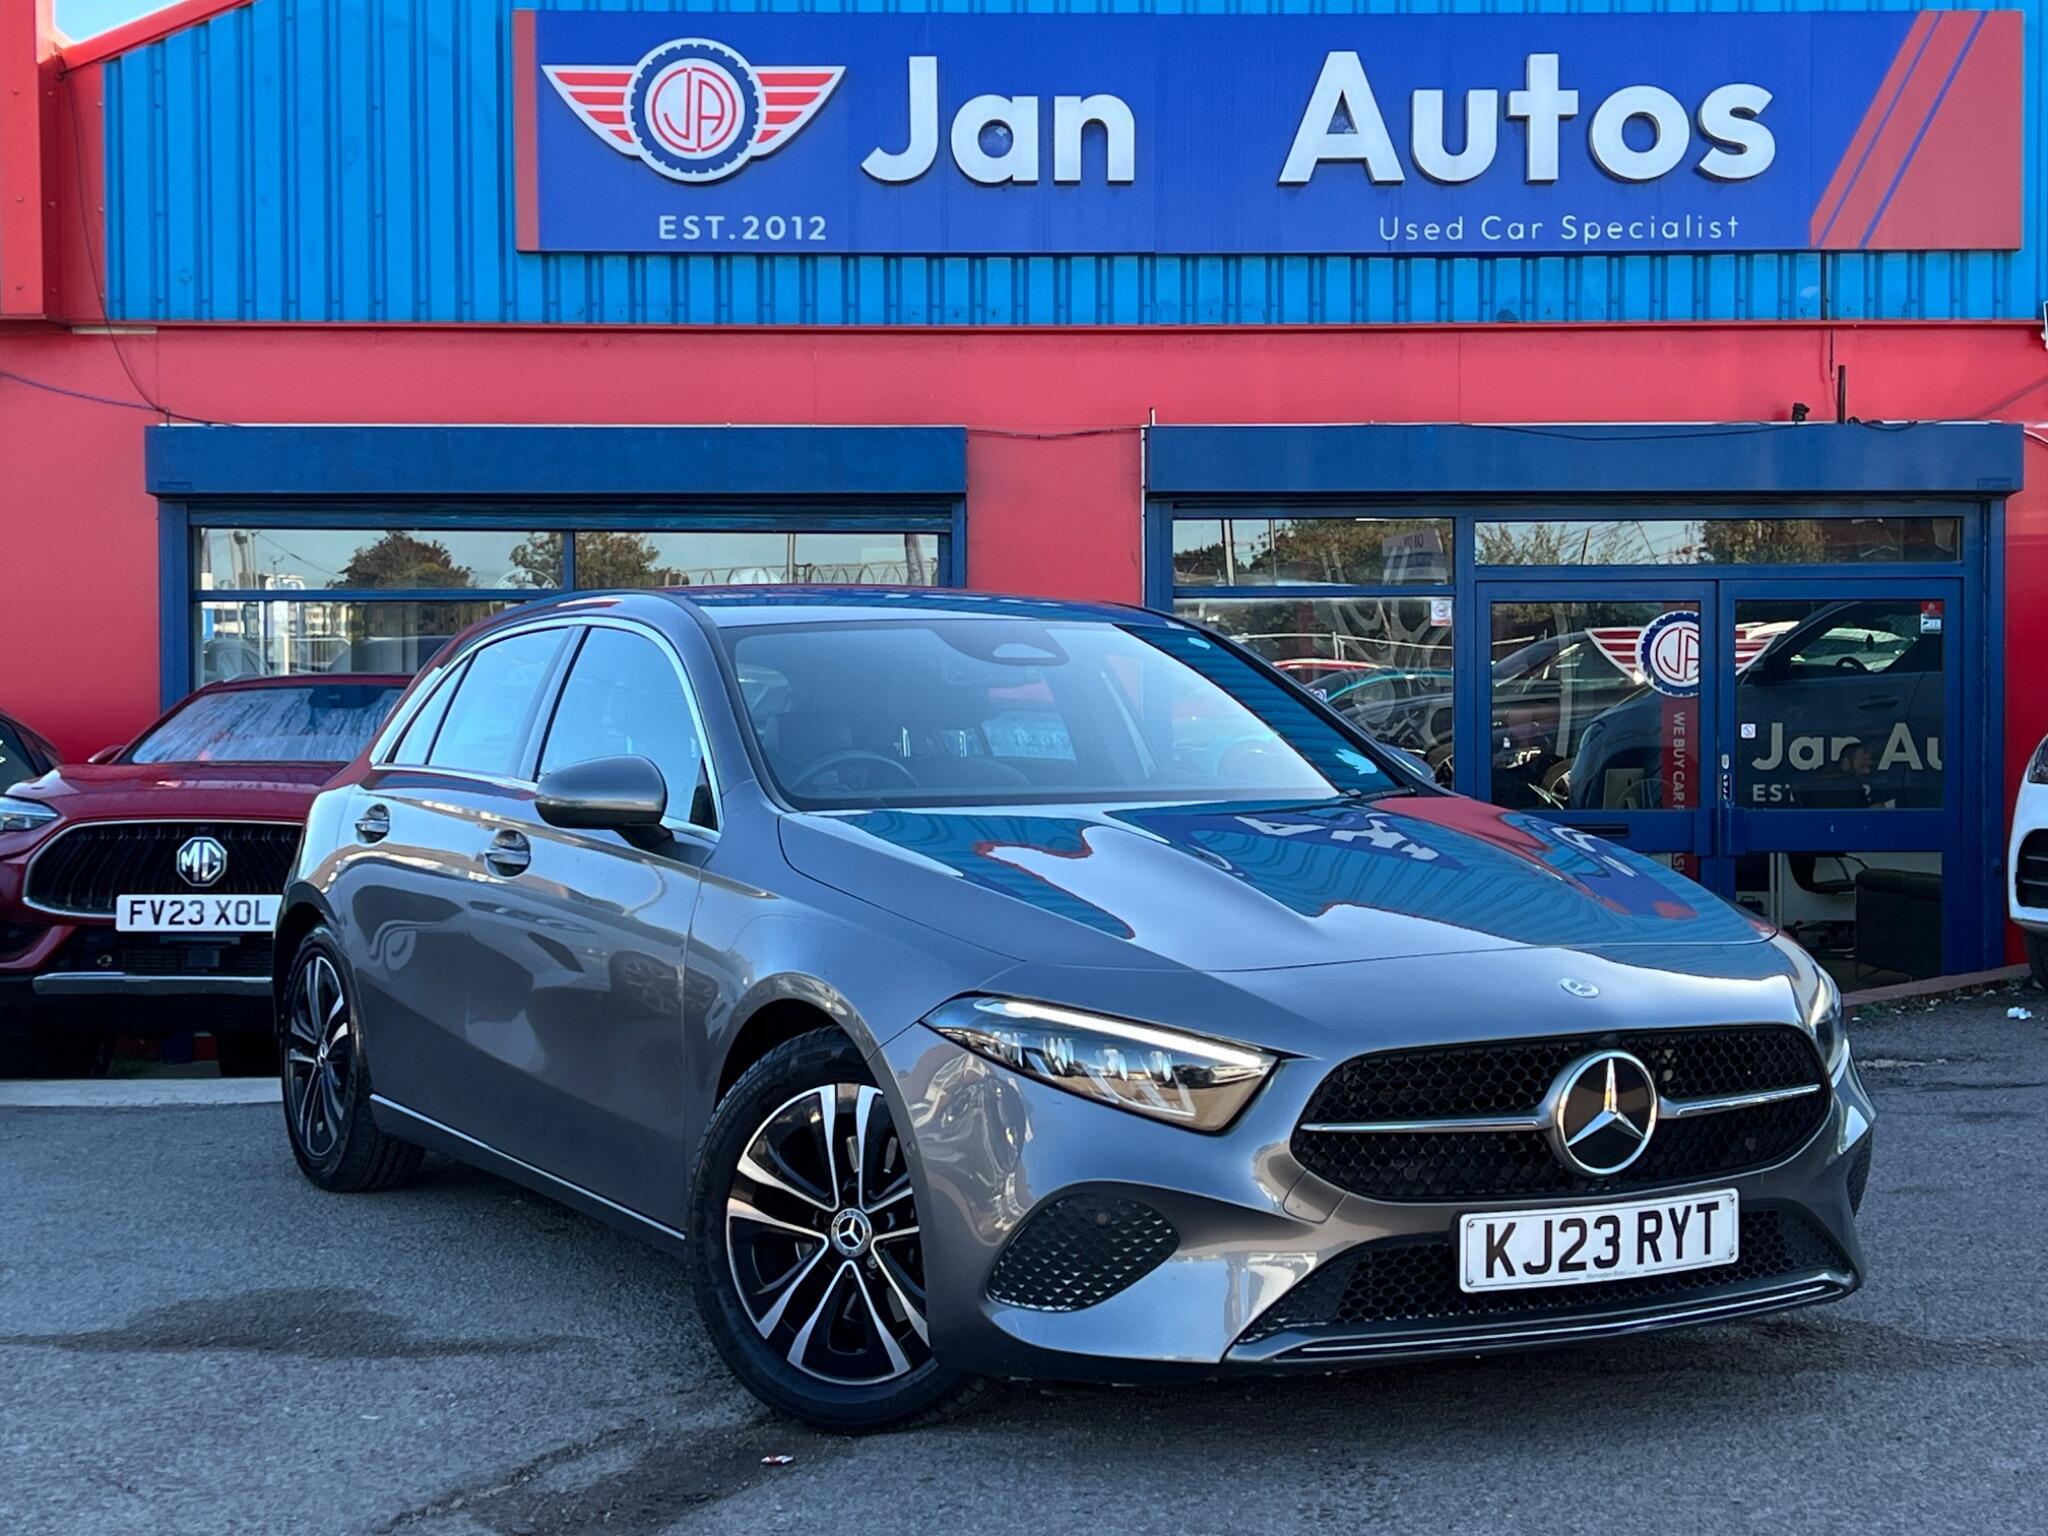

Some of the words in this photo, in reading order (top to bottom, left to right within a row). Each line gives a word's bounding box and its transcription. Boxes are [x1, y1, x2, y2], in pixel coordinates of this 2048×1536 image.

[861, 55, 1135, 184] Jan
[1278, 51, 1776, 183] Autos
[658, 215, 827, 241] EST.2012
[1379, 215, 1464, 241] Used
[1481, 214, 1543, 241] Car
[1560, 213, 1739, 246] Specialist
[1672, 711, 1686, 735] WE
[1672, 738, 1686, 769] BUY
[1672, 771, 1686, 802] CAR
[180, 841, 222, 882] MG
[129, 899, 205, 926] FV23
[1485, 1215, 1621, 1279] KJ23
[1636, 1201, 1720, 1265] RYT
